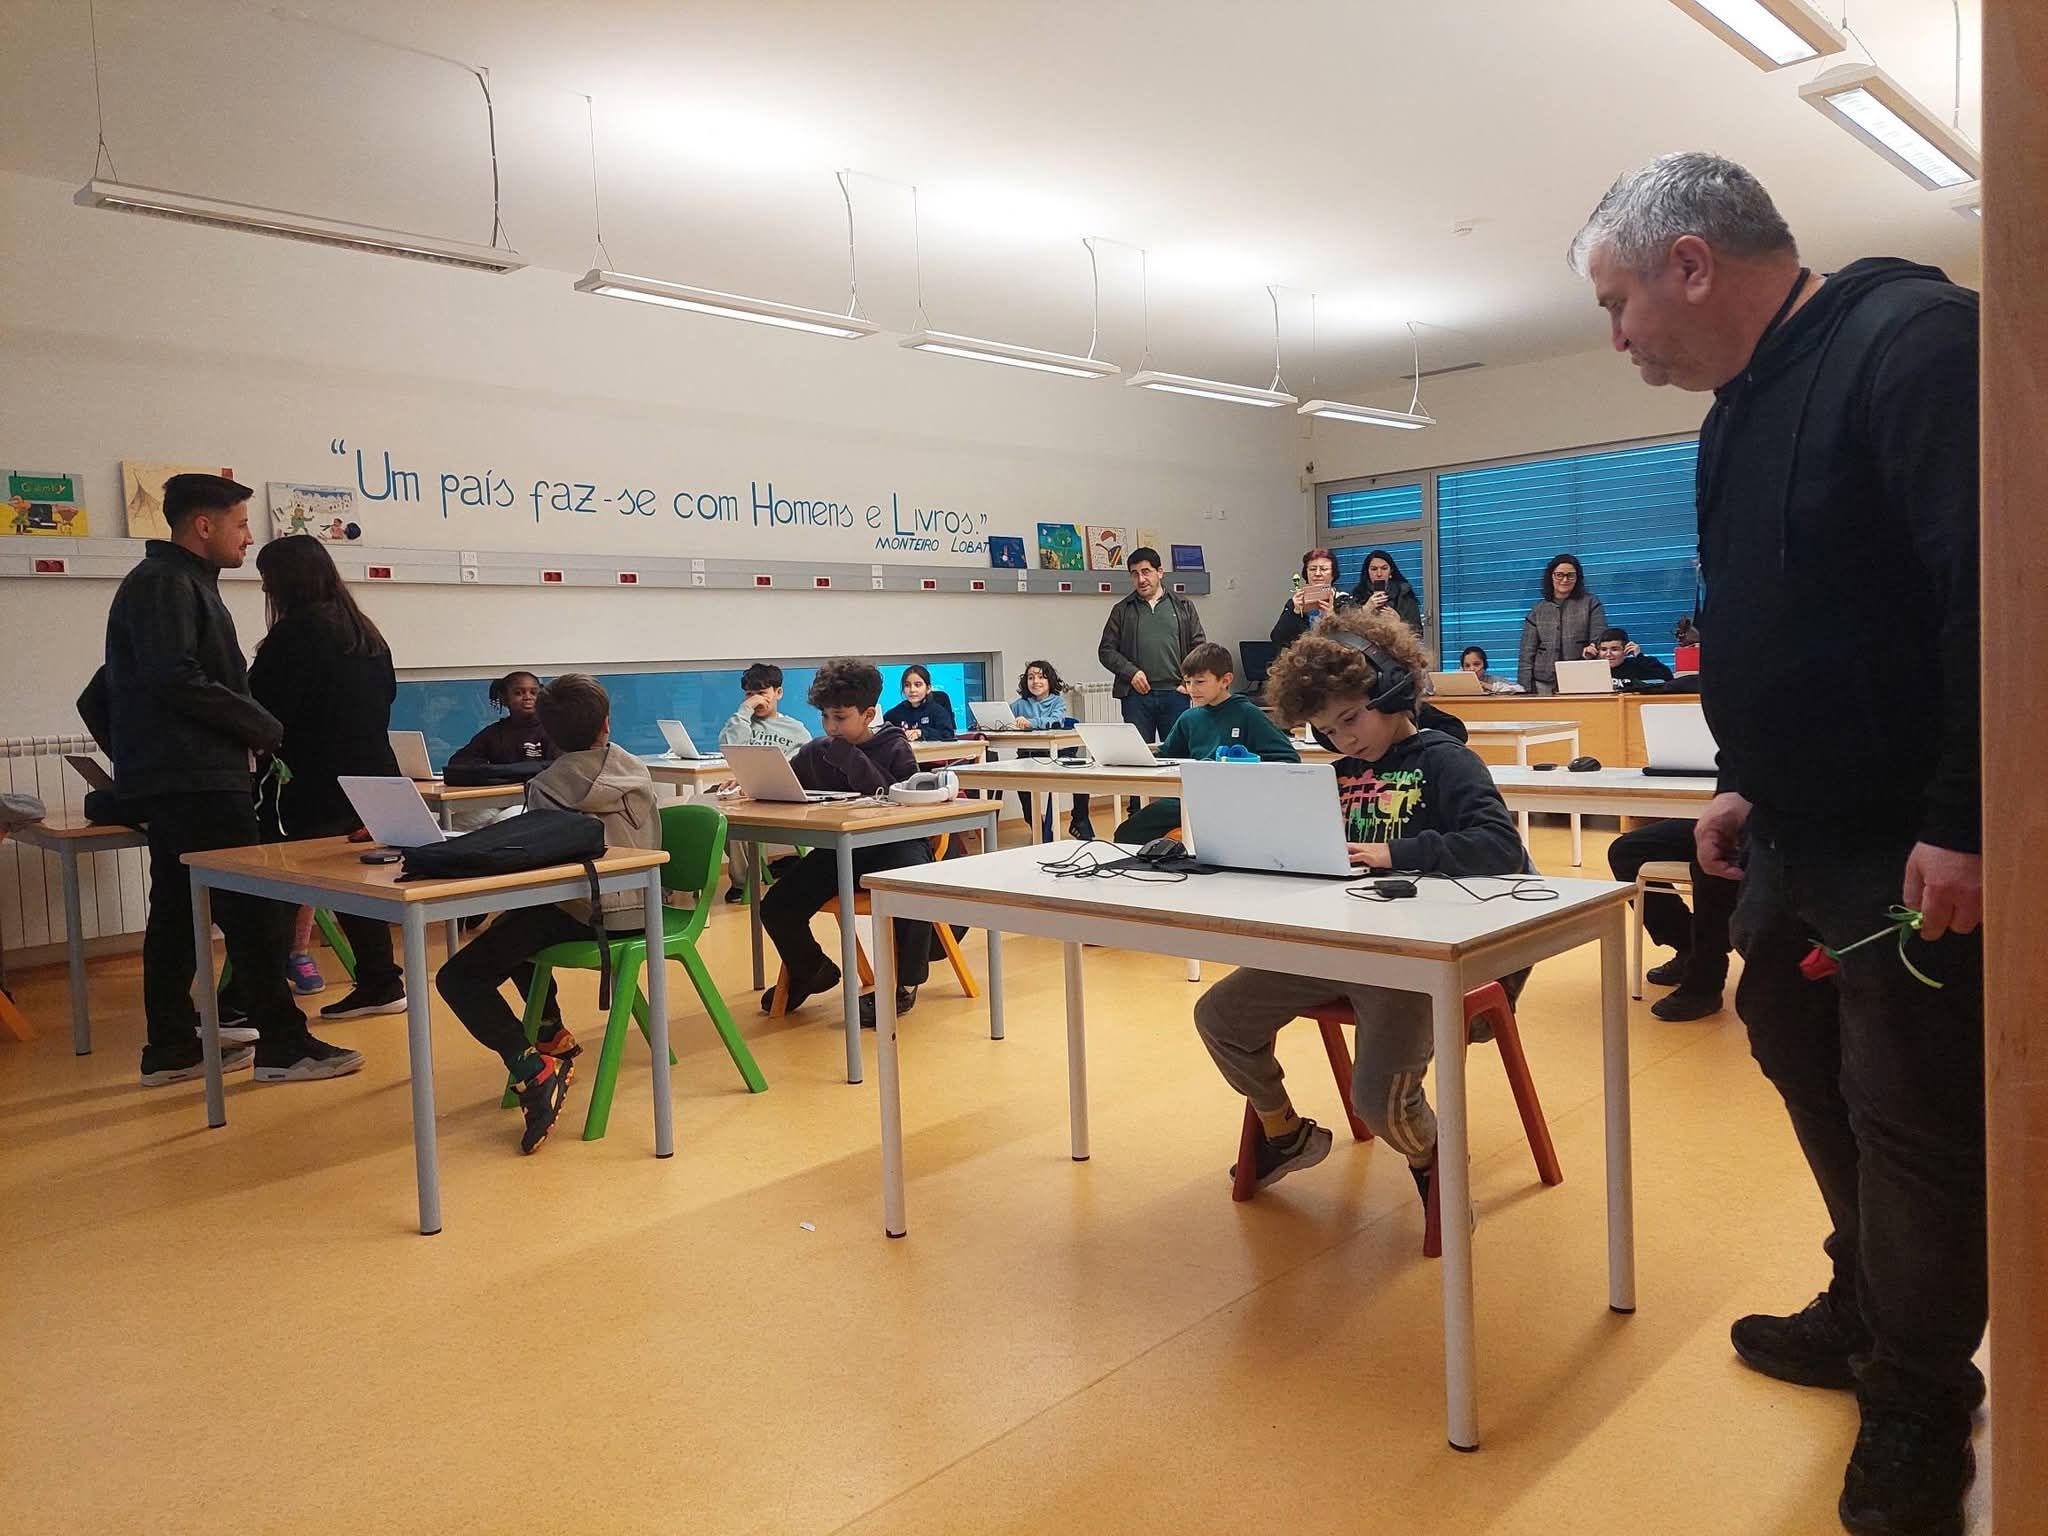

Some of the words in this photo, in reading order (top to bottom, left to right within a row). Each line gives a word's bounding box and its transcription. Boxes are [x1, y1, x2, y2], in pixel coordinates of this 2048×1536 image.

[440, 470, 515, 519] país
[530, 480, 656, 523] faz-se
[674, 492, 738, 521] com
[752, 481, 854, 528] Homens
[866, 505, 882, 529] e
[875, 537, 940, 552] MONTEIRO
[951, 536, 990, 553] LOBAT
